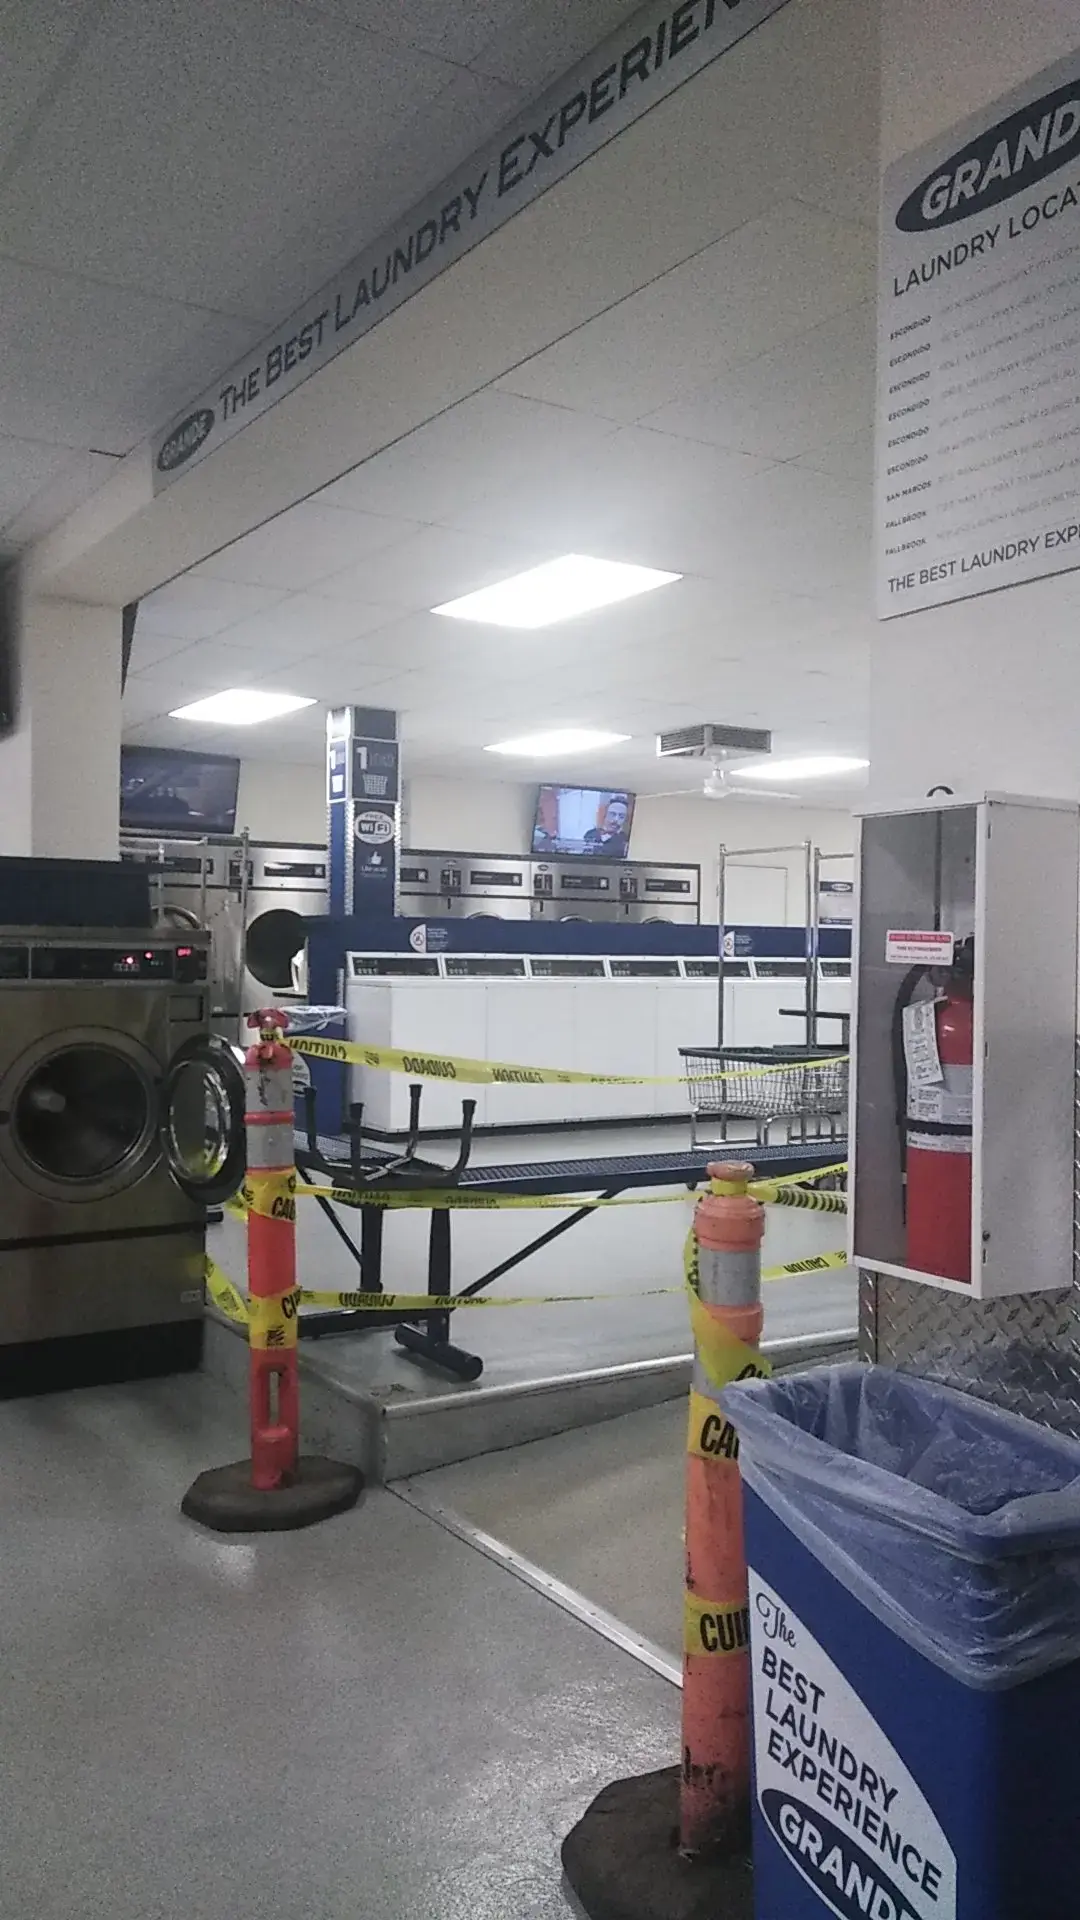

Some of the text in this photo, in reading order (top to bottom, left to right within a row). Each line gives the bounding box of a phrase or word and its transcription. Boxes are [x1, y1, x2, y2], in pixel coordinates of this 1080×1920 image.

[894, 225, 1000, 297] LAUNDRY
[1008, 181, 1080, 239] LOCA
[219, 368, 260, 421] THE
[266, 309, 329, 388] BEST
[335, 171, 488, 332] LAUNDRY
[889, 343, 931, 367] ESCONDIDO
[889, 371, 930, 394] ESCONDIDO
[887, 426, 929, 448] ESCONDIDO
[888, 398, 929, 421] ESCONDIDO
[886, 453, 928, 476] ESCONDIDO
[888, 524, 1080, 592] THE BEST LAUNDRY EXP
[356, 746, 367, 769] 1
[756, 1592, 797, 1647] The
[762, 1646, 825, 1714] BEST
[765, 1688, 898, 1813] LAUNDRY
[767, 1727, 942, 1901] EXPERIENCE
[779, 1803, 910, 1920] GRAND
